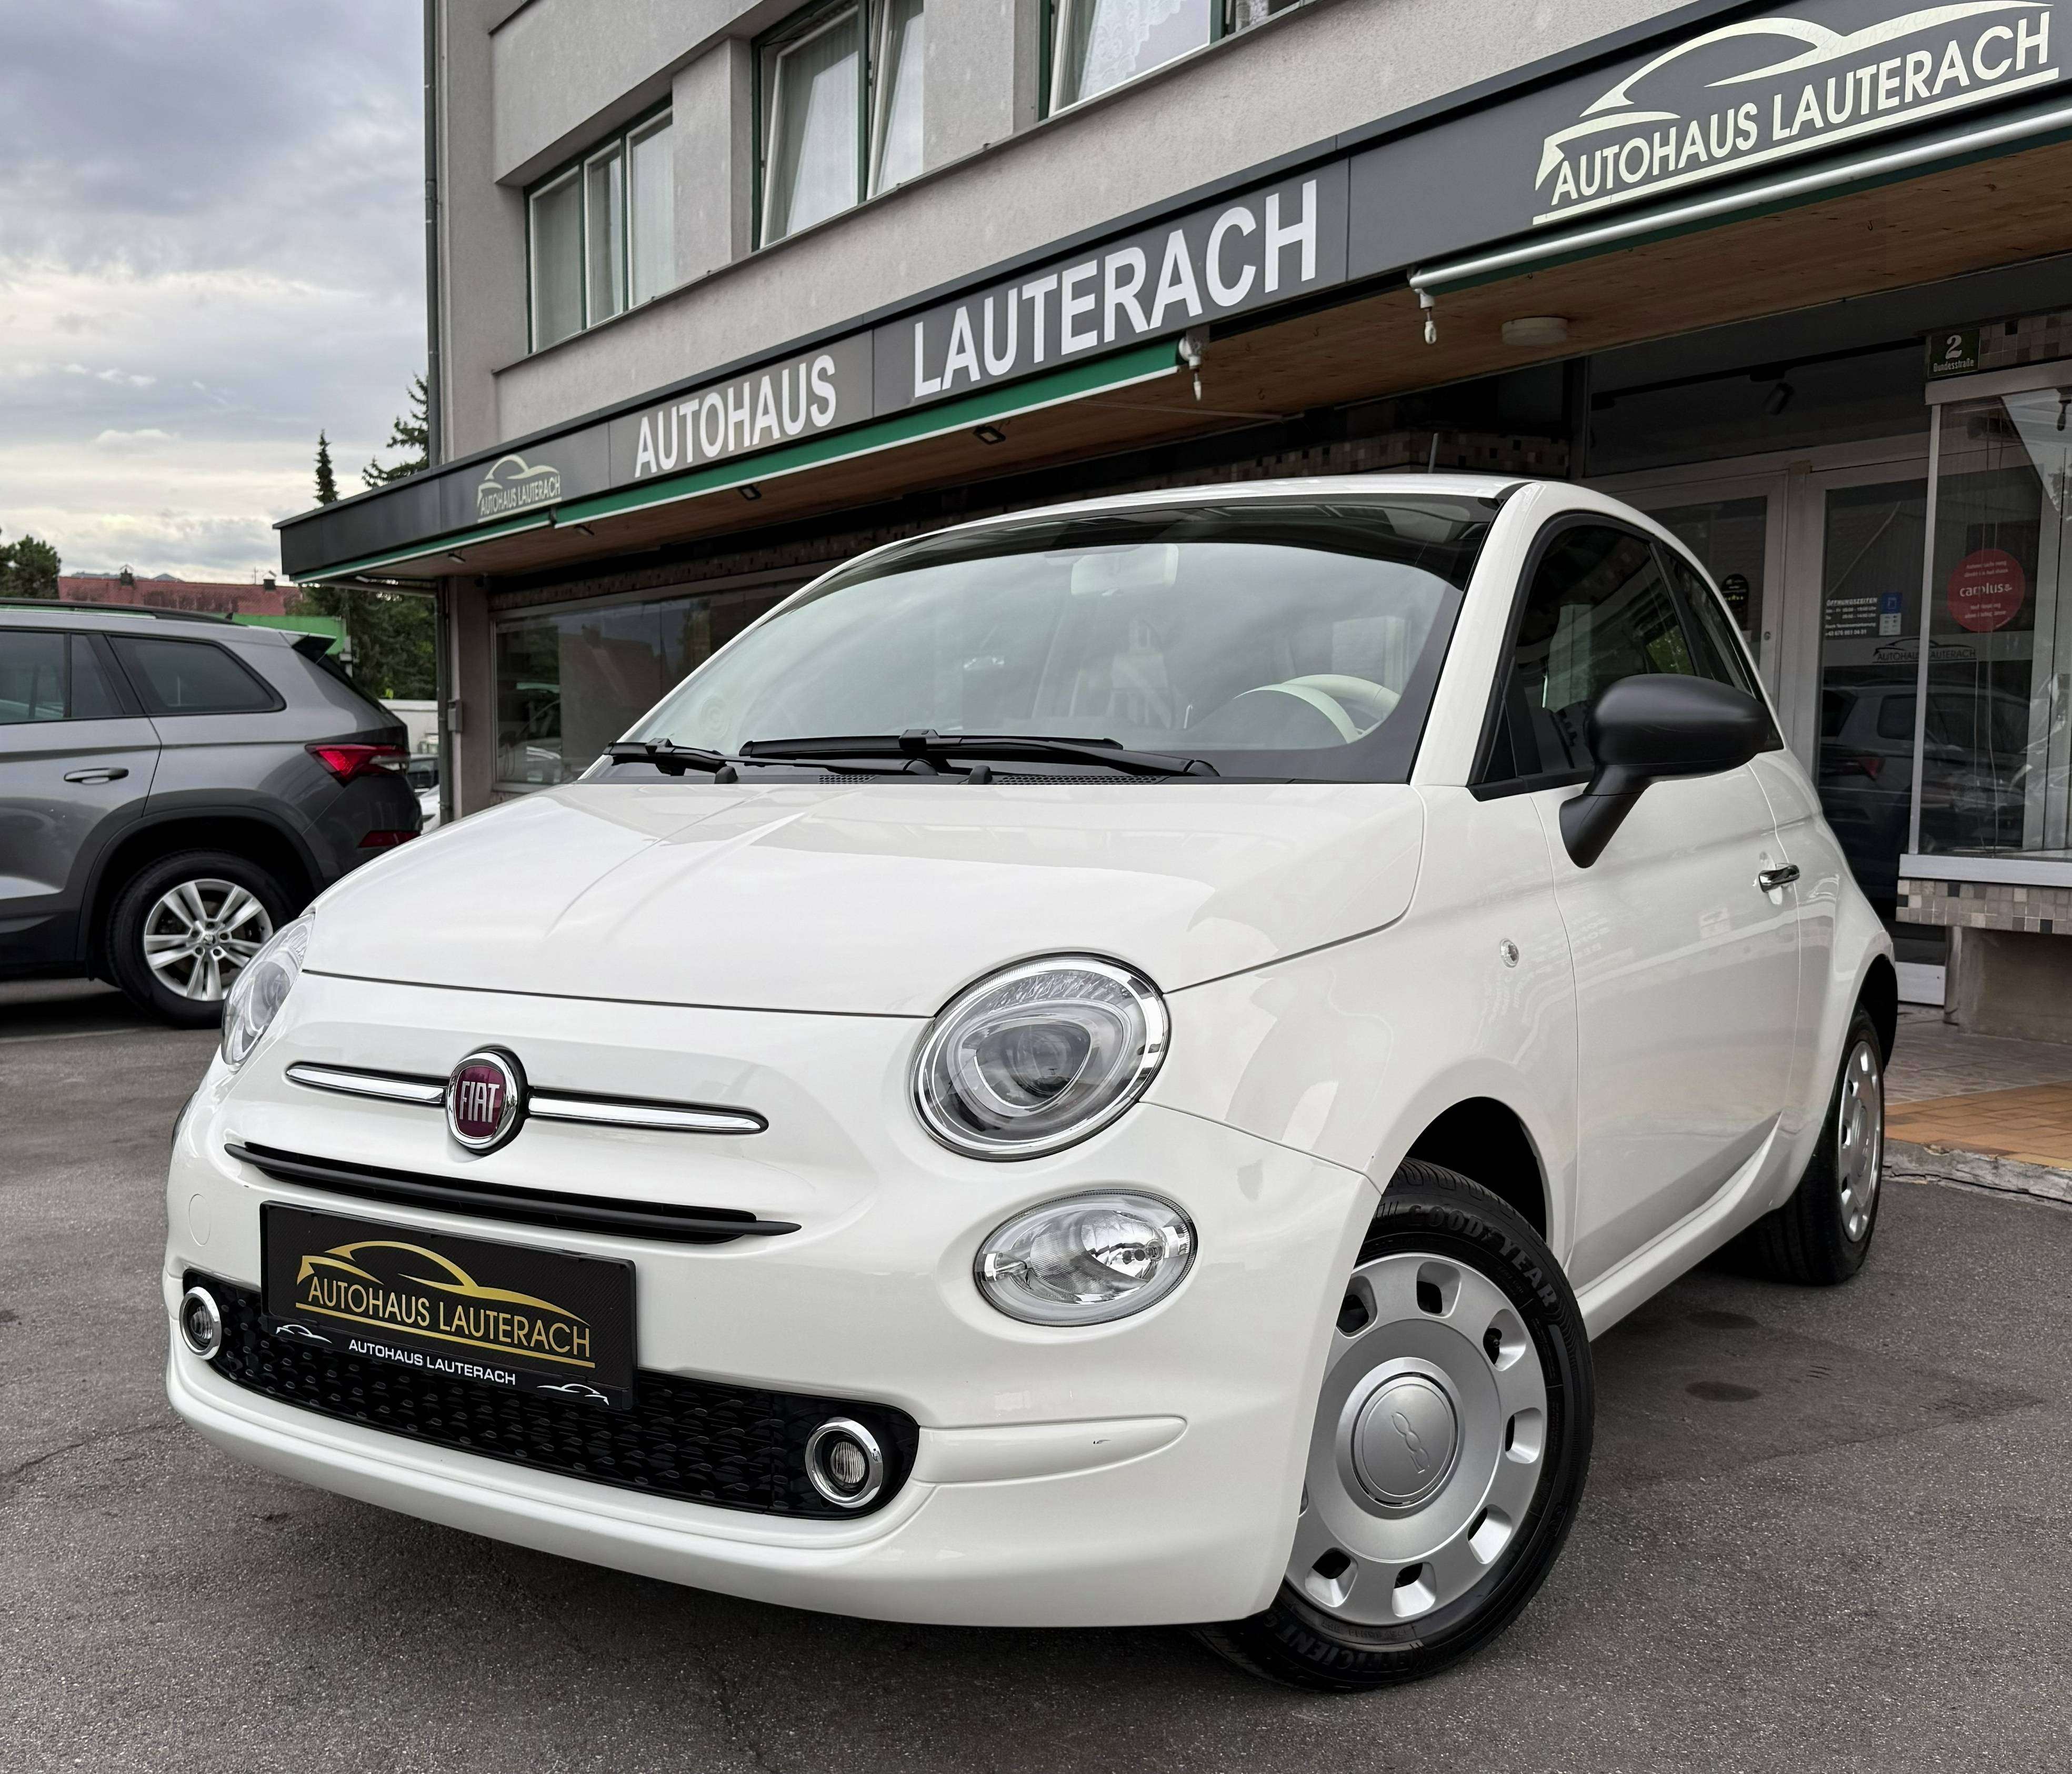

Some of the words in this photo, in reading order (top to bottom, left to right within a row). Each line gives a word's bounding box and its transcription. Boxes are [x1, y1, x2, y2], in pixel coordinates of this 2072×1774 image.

[1551, 103, 1758, 206] AUTOHAUS
[1773, 11, 2050, 141] LAUTERACH
[635, 355, 836, 478] AUTOHAUS
[915, 179, 1316, 398] LAUTERACH
[1945, 335, 1963, 359] 2
[481, 487, 516, 516] AUTOHAUS
[518, 475, 560, 506] LAUTERACH
[1877, 651, 1919, 662] AUTOHAU
[1930, 649, 1976, 659] AUTERACH
[459, 1081, 500, 1123] FIAT
[308, 1276, 429, 1327] AUTOHAUS
[439, 1301, 589, 1357] LAUTERACH
[348, 1339, 423, 1366] AUTOHAUS
[427, 1356, 516, 1385] LAUTERACH
